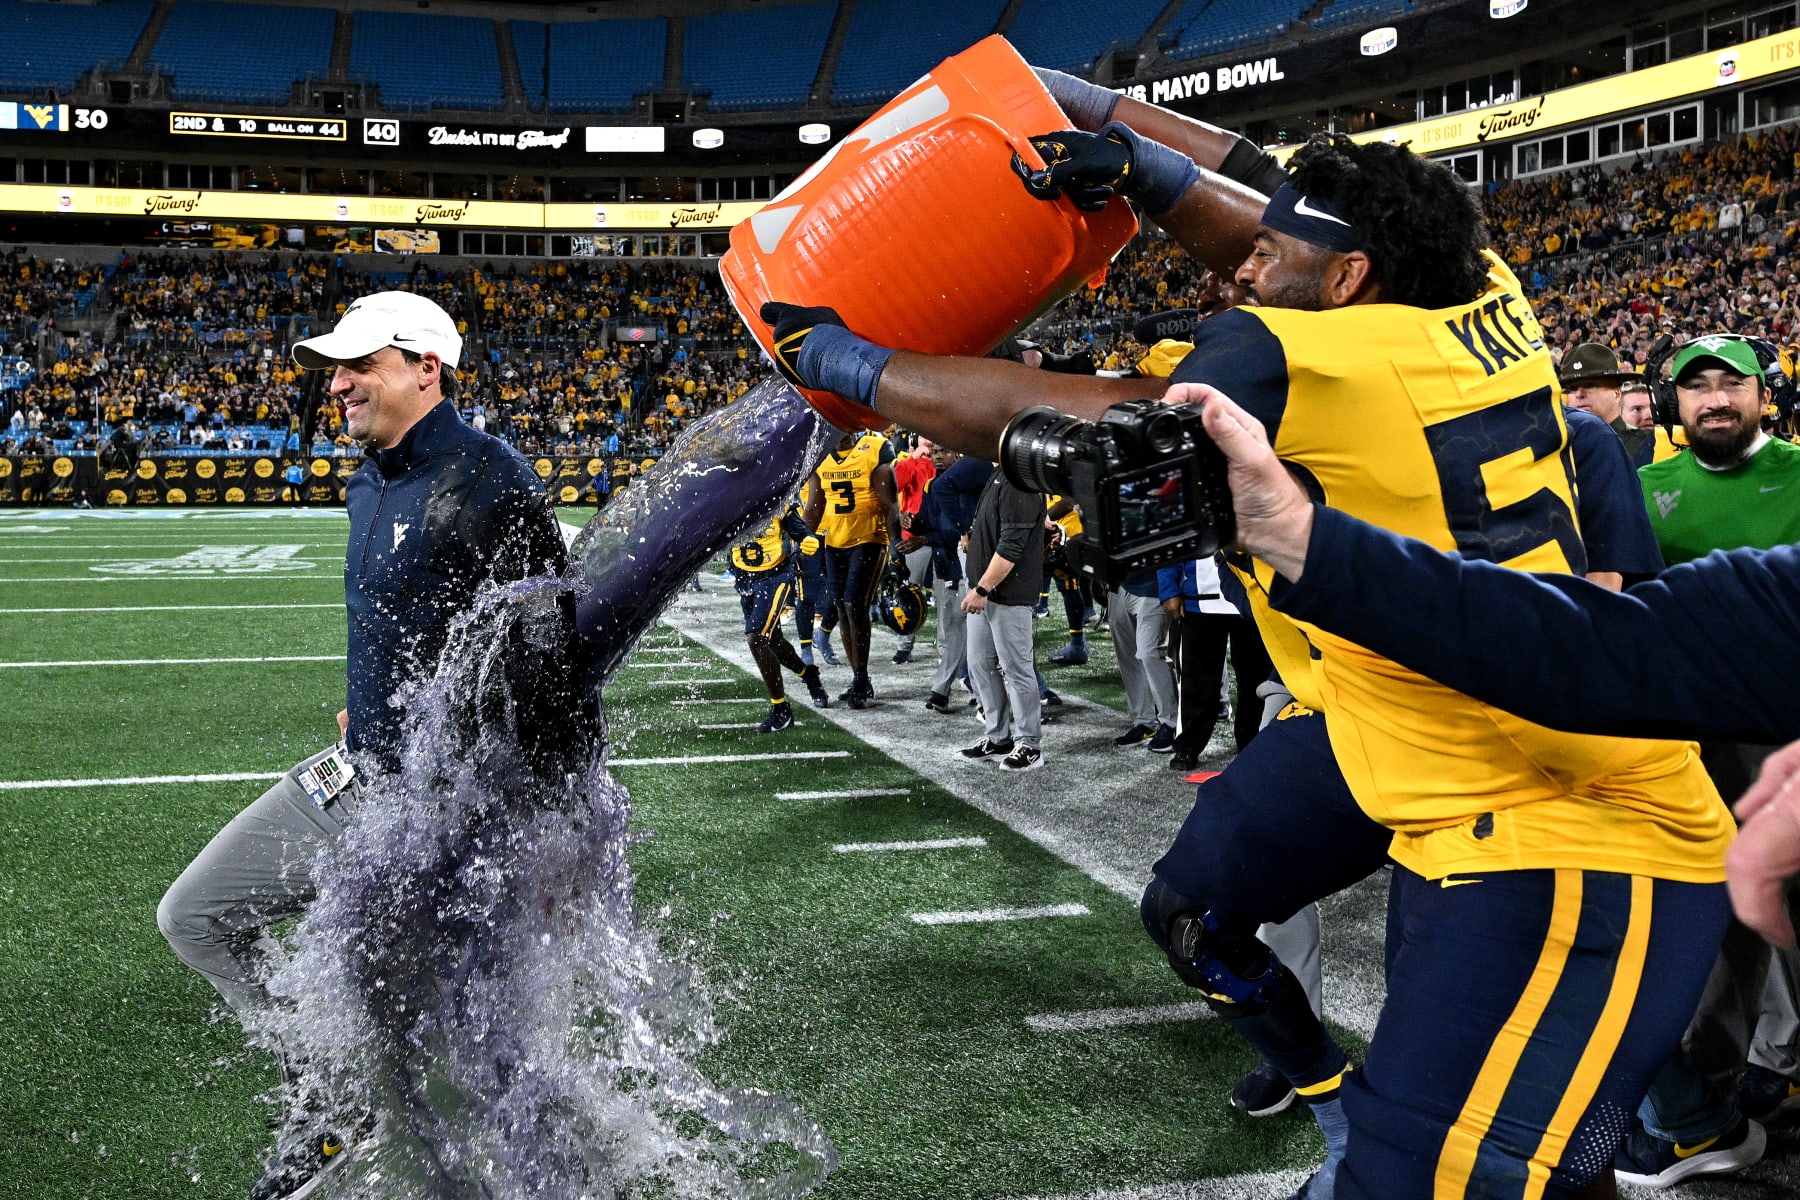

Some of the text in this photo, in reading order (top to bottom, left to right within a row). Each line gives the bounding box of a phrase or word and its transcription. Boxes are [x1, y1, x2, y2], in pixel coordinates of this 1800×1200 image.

[1770, 40, 1795, 63] IT'S
[1152, 72, 1210, 103] MAYO
[1216, 57, 1285, 92] BOWL
[74, 108, 108, 129] 30
[174, 116, 340, 136] 2ND & 10 BALL ON 44
[1422, 95, 1545, 145] IT'S GOT Twang!
[367, 123, 396, 140] 40
[427, 126, 482, 146] Duke's
[143, 191, 202, 216] Twang!
[415, 200, 470, 224] Twang!
[669, 202, 722, 229] Twang!
[1444, 293, 1544, 377] YATE
[830, 480, 856, 515] 3
